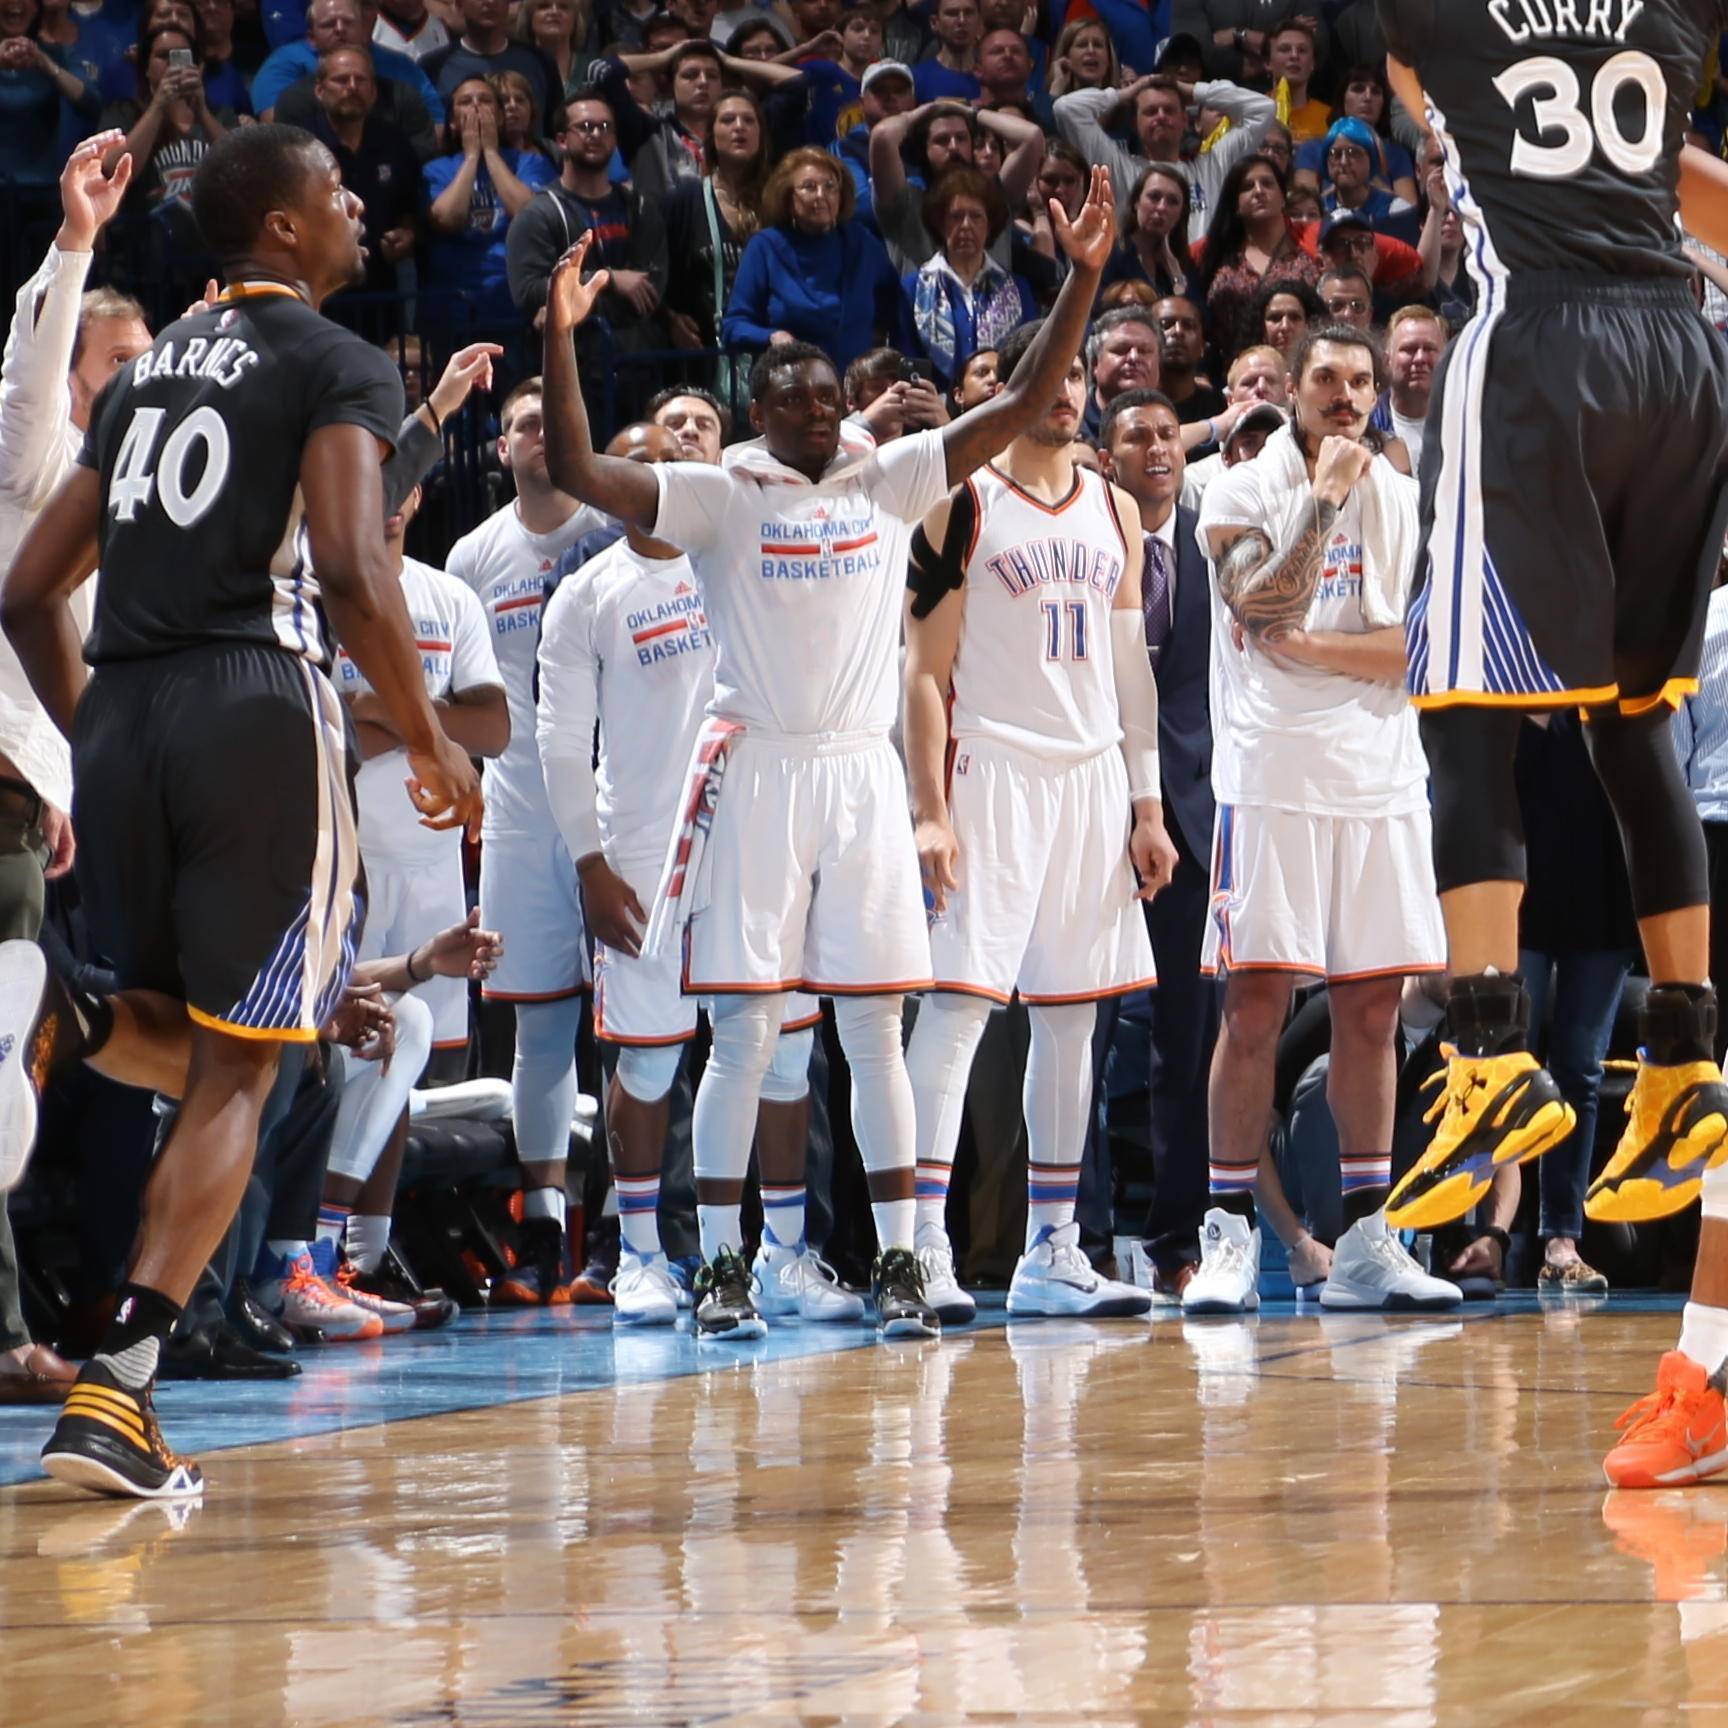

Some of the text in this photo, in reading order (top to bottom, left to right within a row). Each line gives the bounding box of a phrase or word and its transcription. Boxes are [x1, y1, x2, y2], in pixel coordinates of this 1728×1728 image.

[1491, 49, 1668, 180] 30
[133, 337, 260, 389] BARNES
[108, 406, 232, 529] 40
[760, 522, 852, 541] OKLAHOMA
[492, 575, 545, 601] OKLAHO
[761, 556, 883, 580] BASKETBALL
[985, 538, 1120, 598] THUNDER
[626, 596, 704, 629] OKLAHOM
[1039, 599, 1088, 662] 11
[637, 630, 713, 667] BASKET
